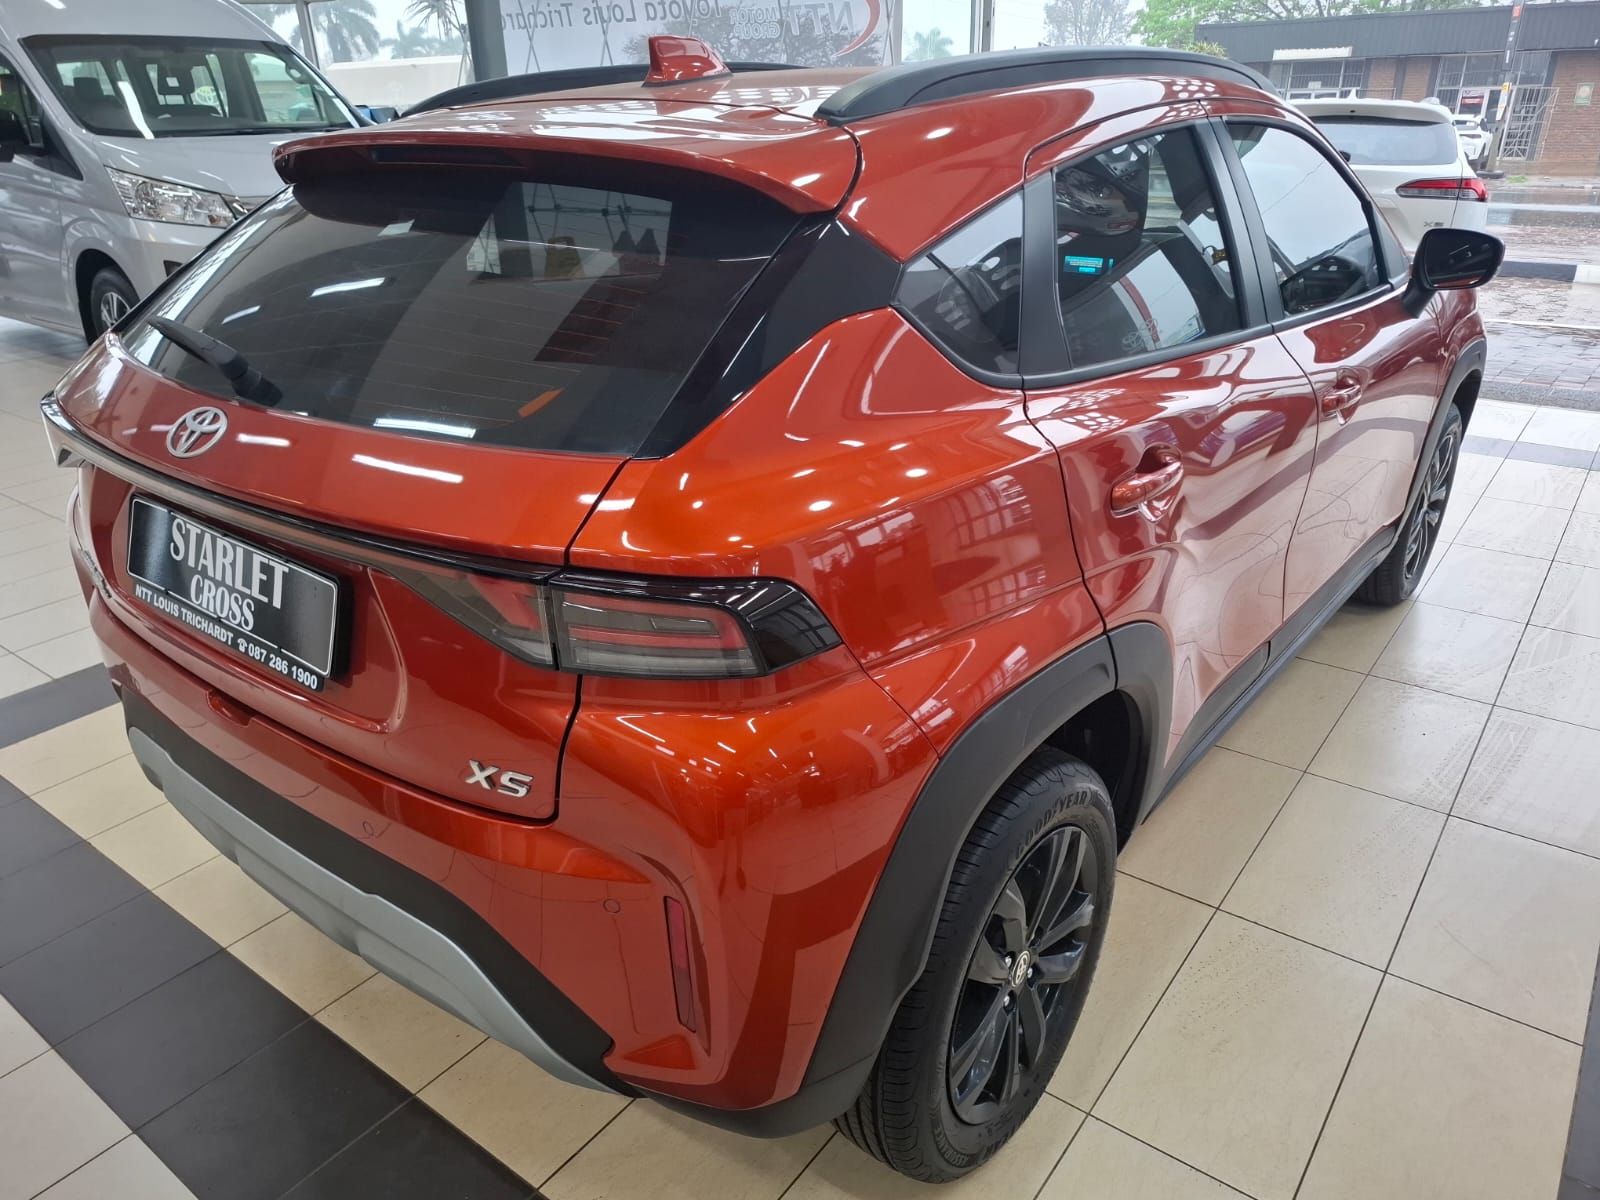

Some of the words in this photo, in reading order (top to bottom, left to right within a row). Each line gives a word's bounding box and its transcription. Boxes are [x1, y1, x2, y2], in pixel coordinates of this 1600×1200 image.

[170, 518, 289, 609] STARLET
[135, 584, 152, 602] NTT
[153, 593, 179, 617] LOUIS
[181, 606, 234, 646] TRICHARDT
[248, 642, 266, 663] 087
[269, 653, 288, 675] 286
[291, 665, 318, 690] 1900
[190, 574, 255, 632] CROSS
[464, 759, 534, 798] XS
